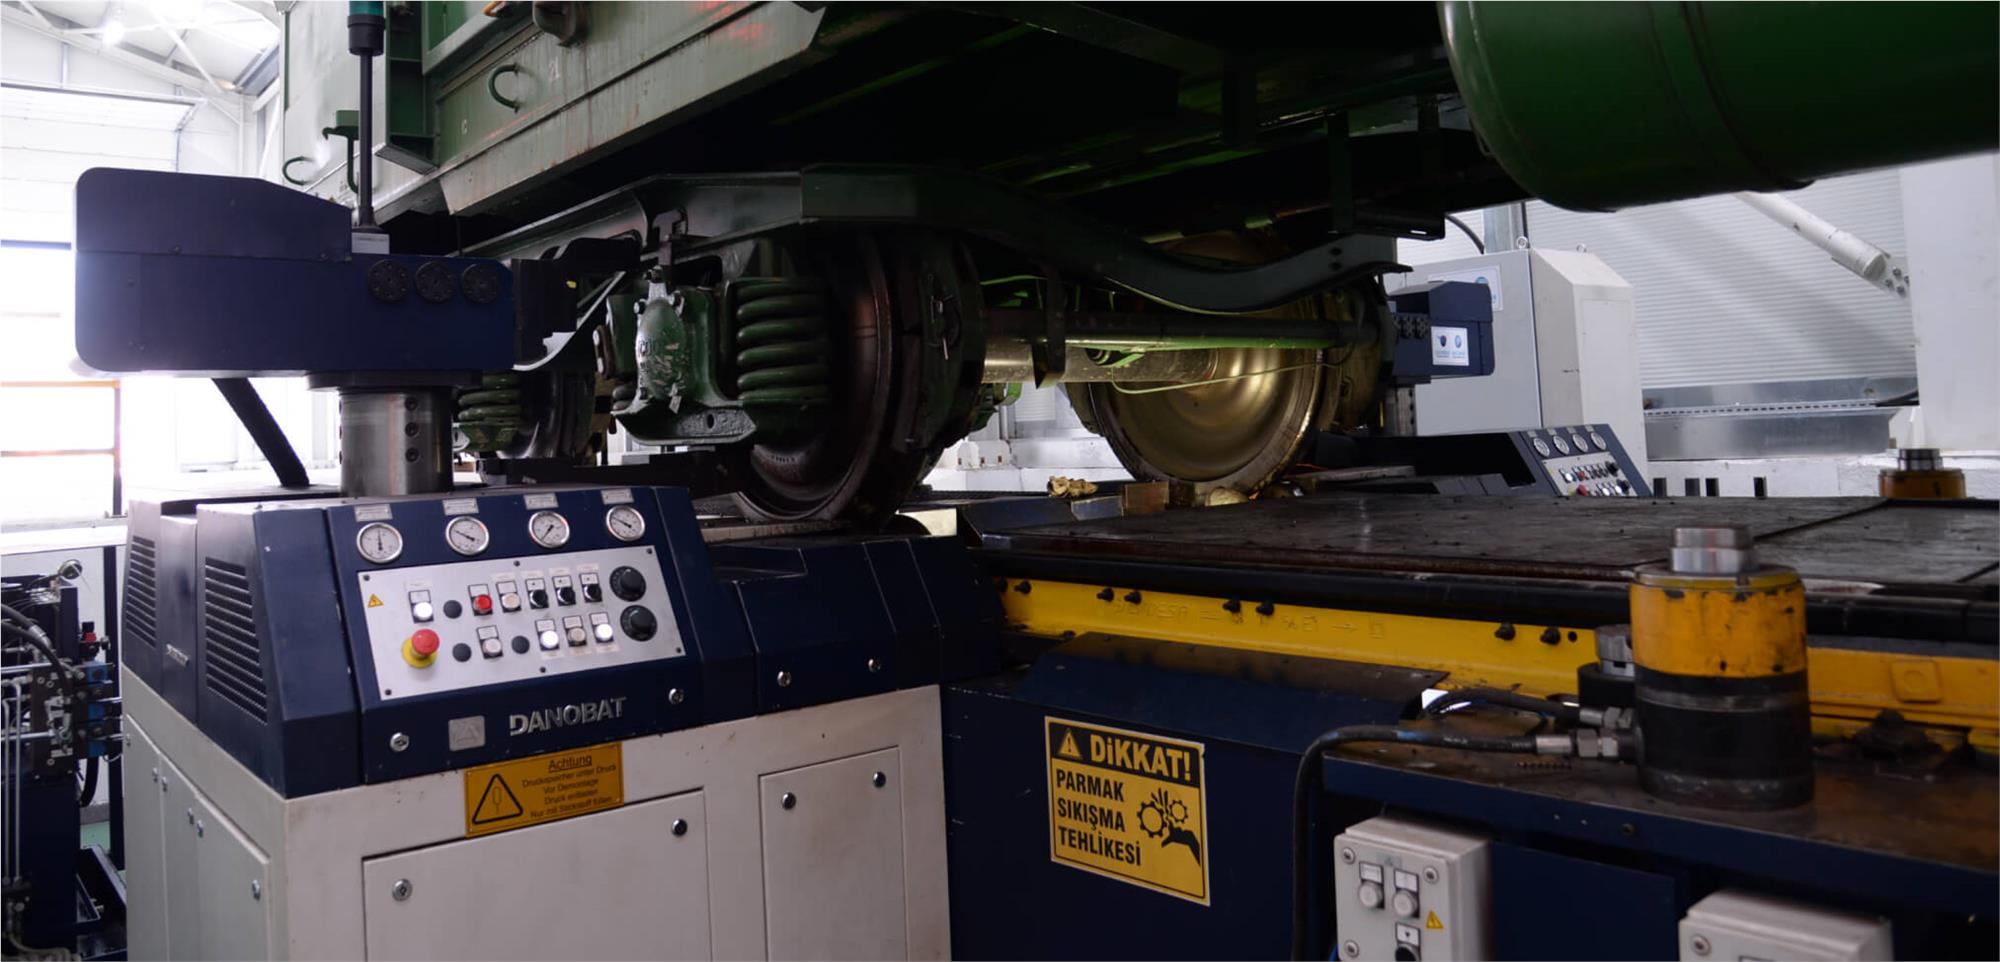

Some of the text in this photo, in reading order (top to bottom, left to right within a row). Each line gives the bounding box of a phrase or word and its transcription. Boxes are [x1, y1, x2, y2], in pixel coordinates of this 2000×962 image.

[510, 697, 627, 736] DANOBAT
[548, 755, 592, 771] Achtung
[596, 763, 616, 774] Druck
[543, 778, 599, 794] Vor Demontage
[1056, 769, 1124, 801] PARMAK
[1058, 798, 1125, 831] SIKIŞMA
[1058, 826, 1141, 866] TEHLİKESİ
